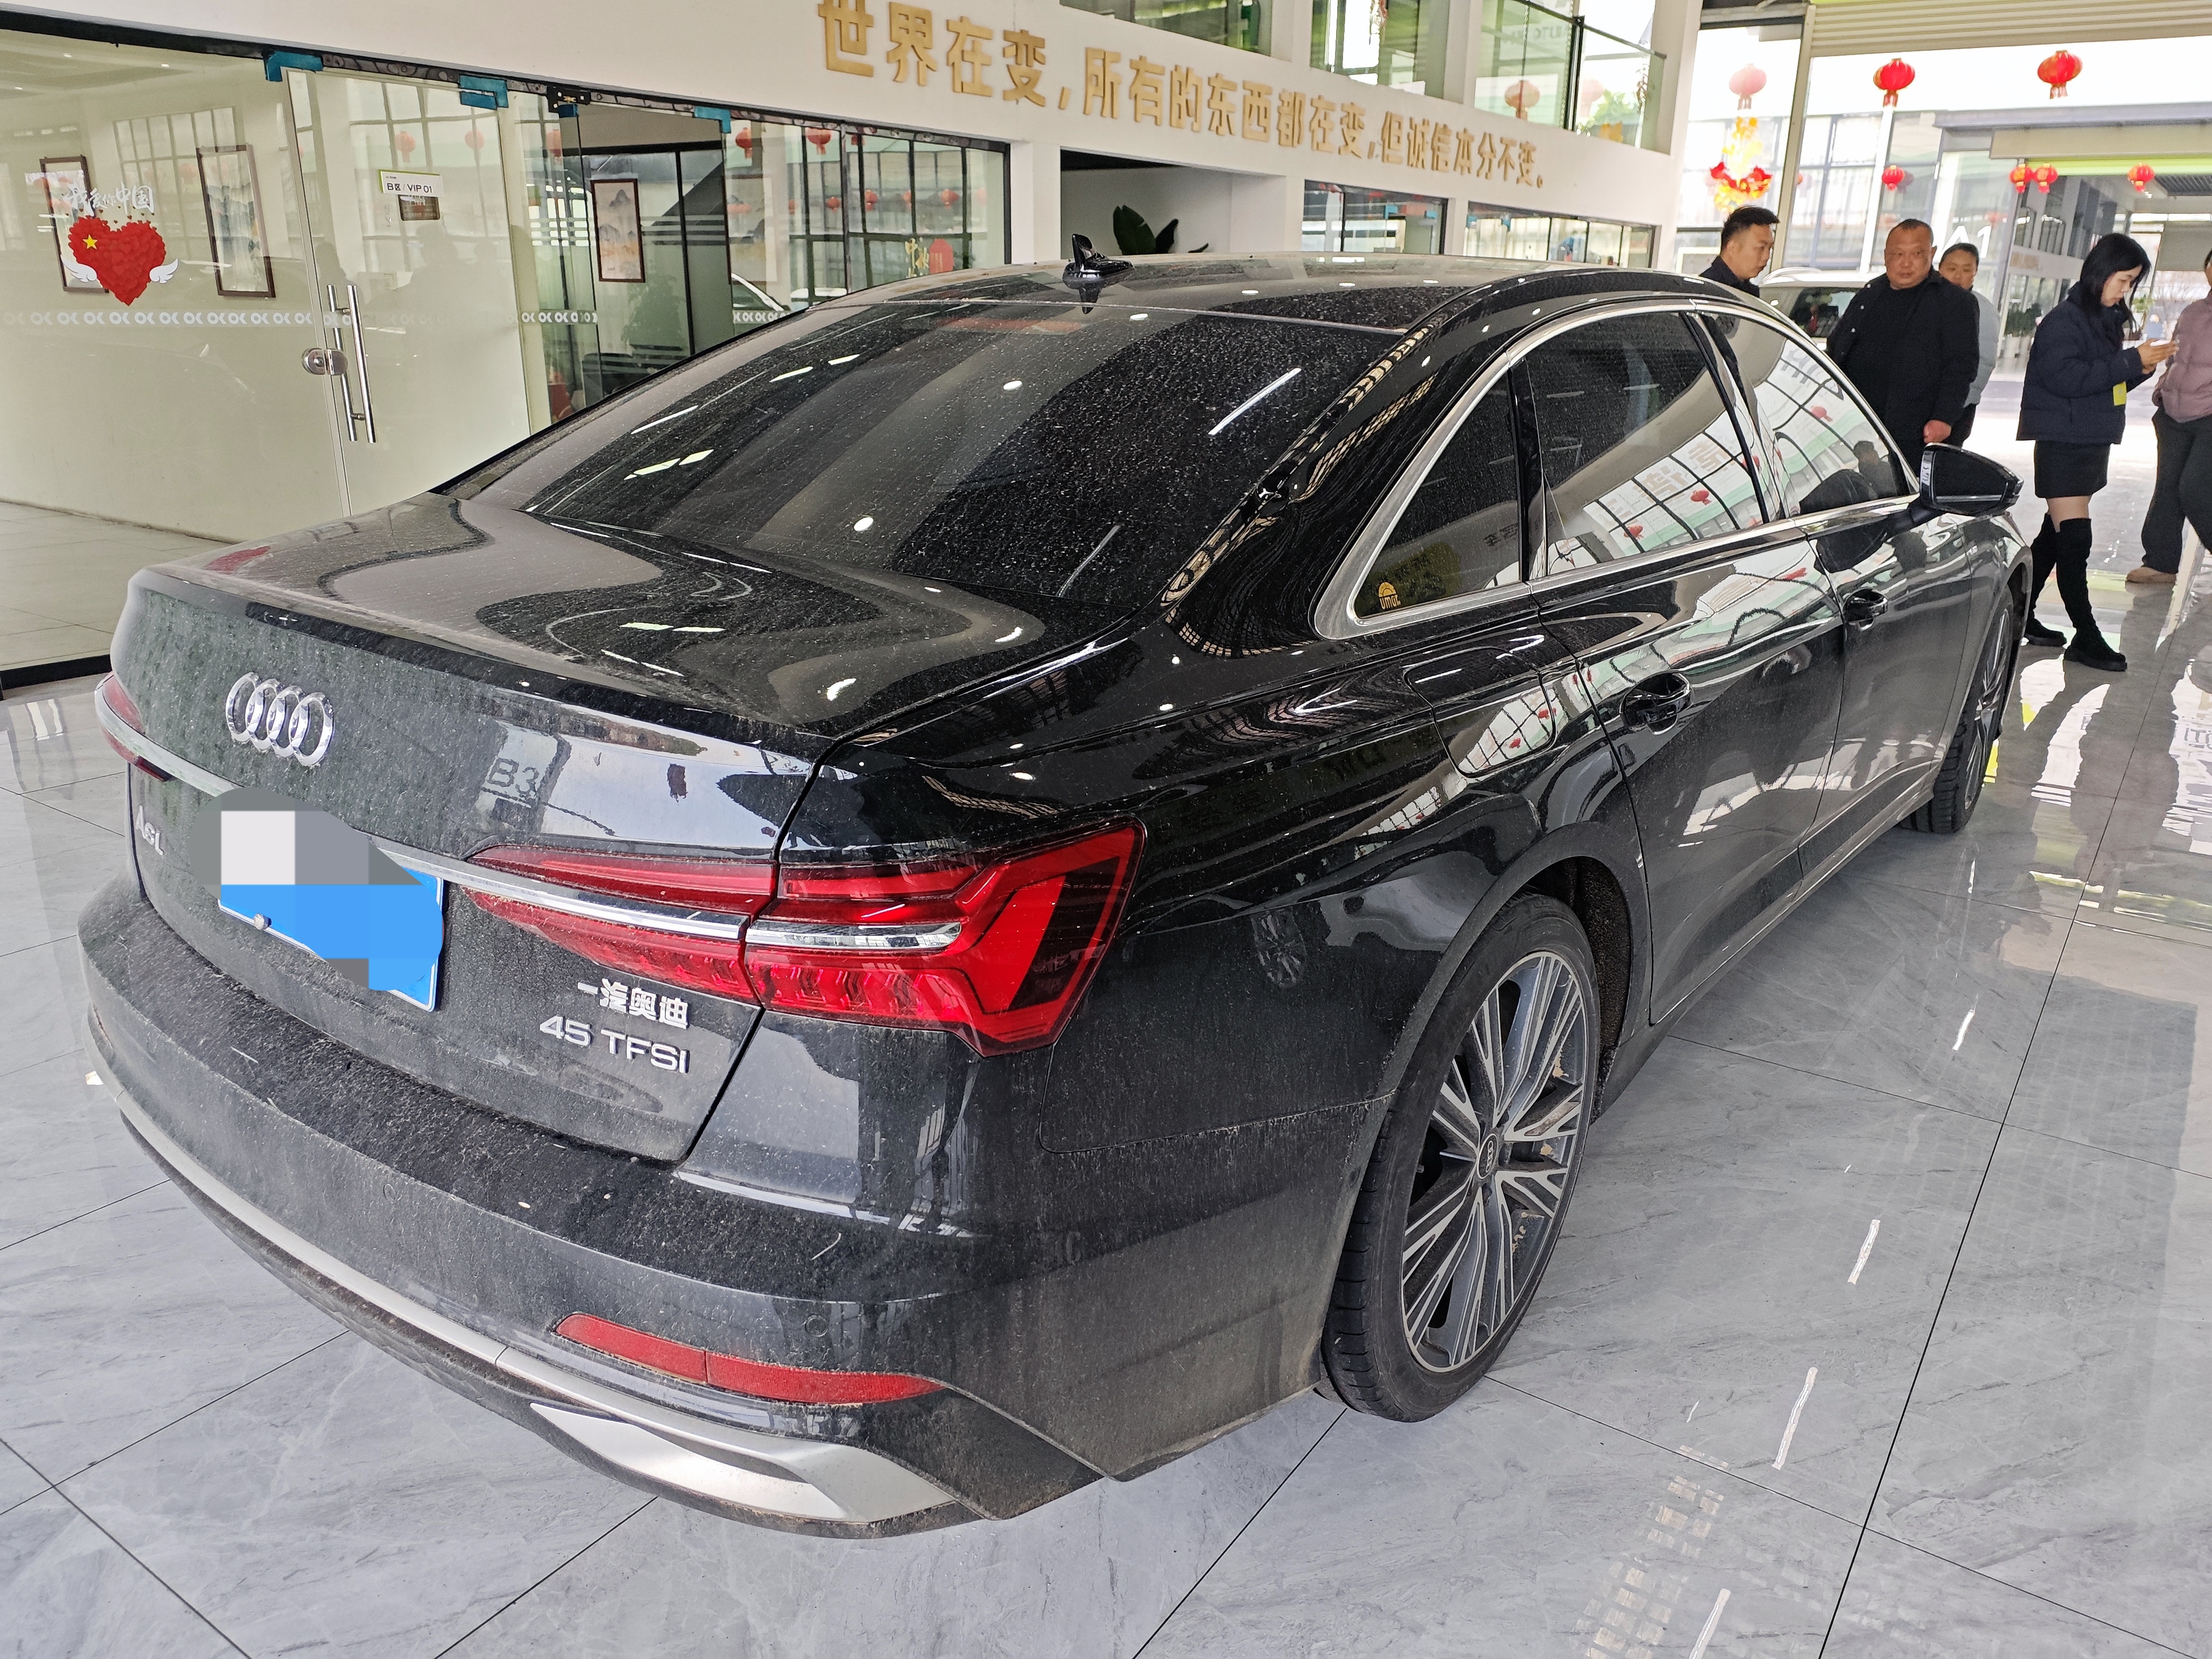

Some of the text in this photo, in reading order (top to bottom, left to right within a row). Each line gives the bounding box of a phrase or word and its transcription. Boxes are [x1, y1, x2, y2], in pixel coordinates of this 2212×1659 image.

[63, 181, 154, 217] 我爱你中国
[135, 805, 164, 855] A6L
[578, 978, 689, 1029] 一汽奥迪
[539, 1015, 690, 1074] 45 TFSI
